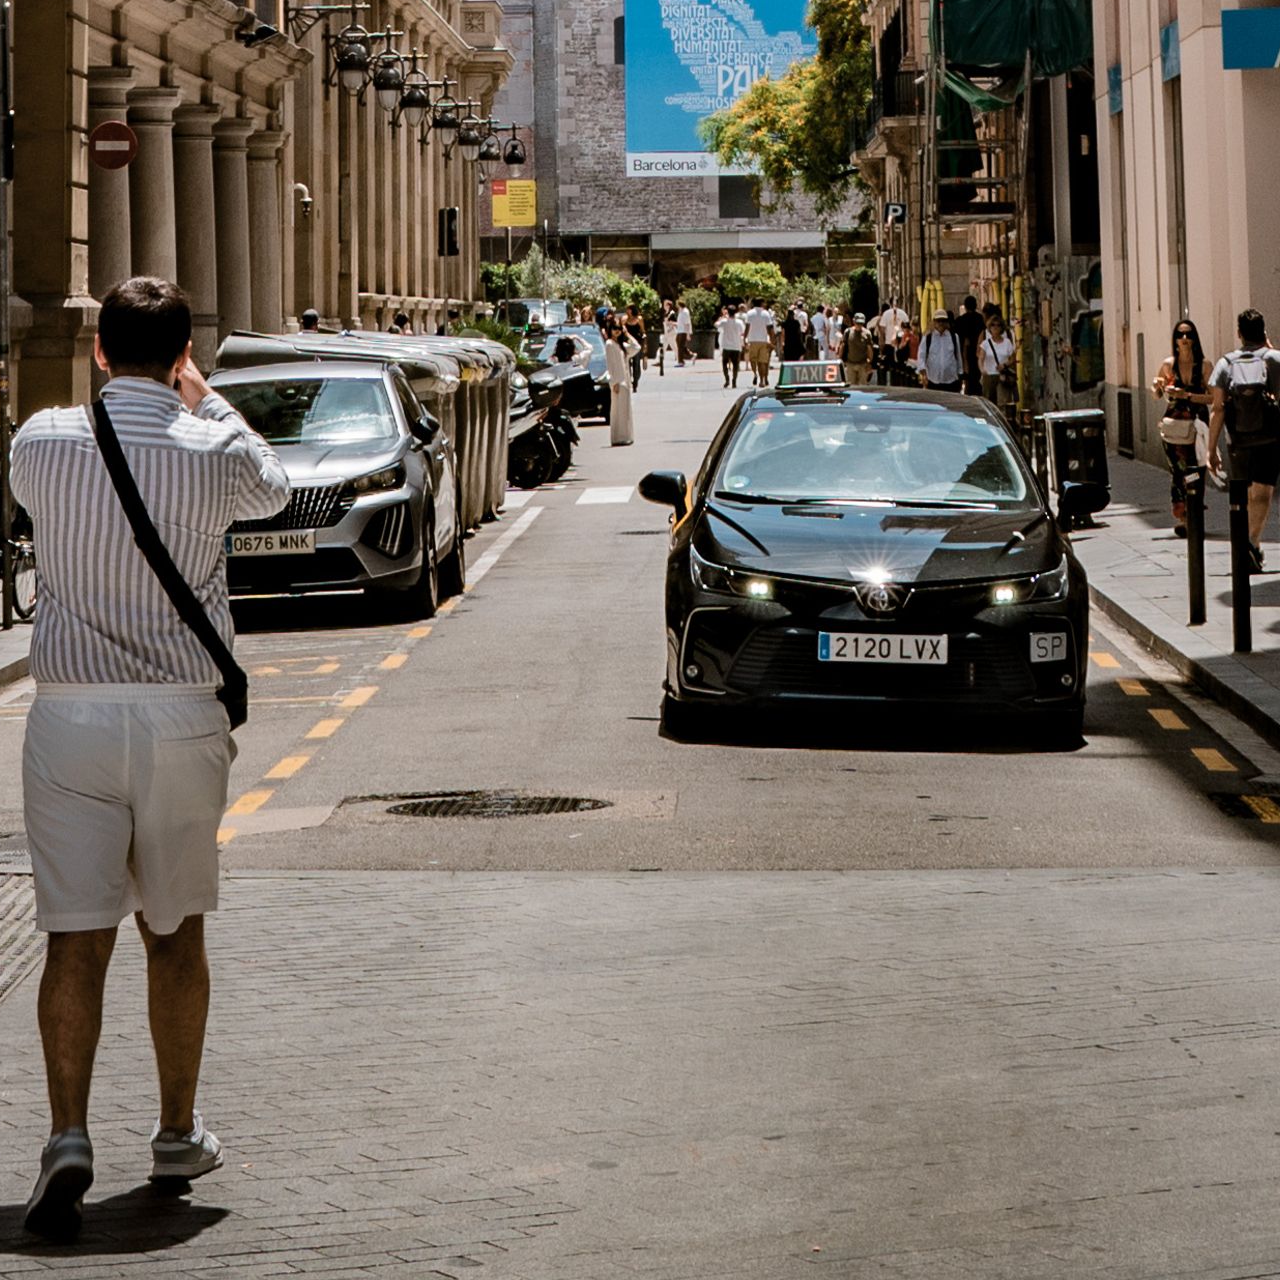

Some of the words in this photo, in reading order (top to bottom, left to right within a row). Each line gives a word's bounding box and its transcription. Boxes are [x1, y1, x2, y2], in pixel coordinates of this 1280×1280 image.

[661, 5, 711, 18] DIGNITAT
[683, 17, 728, 27] RESPECTE
[670, 27, 735, 40] DIVERSITAT
[674, 40, 742, 53] HUMANITAT
[706, 53, 774, 69] ESPERANÇA
[633, 159, 697, 171] Barcelona
[793, 366, 823, 383] TAXI
[233, 536, 274, 552] 0676
[279, 534, 310, 550] MNK
[835, 637, 891, 658] 2120
[899, 638, 941, 660] LVX
[1036, 636, 1063, 658] SP
